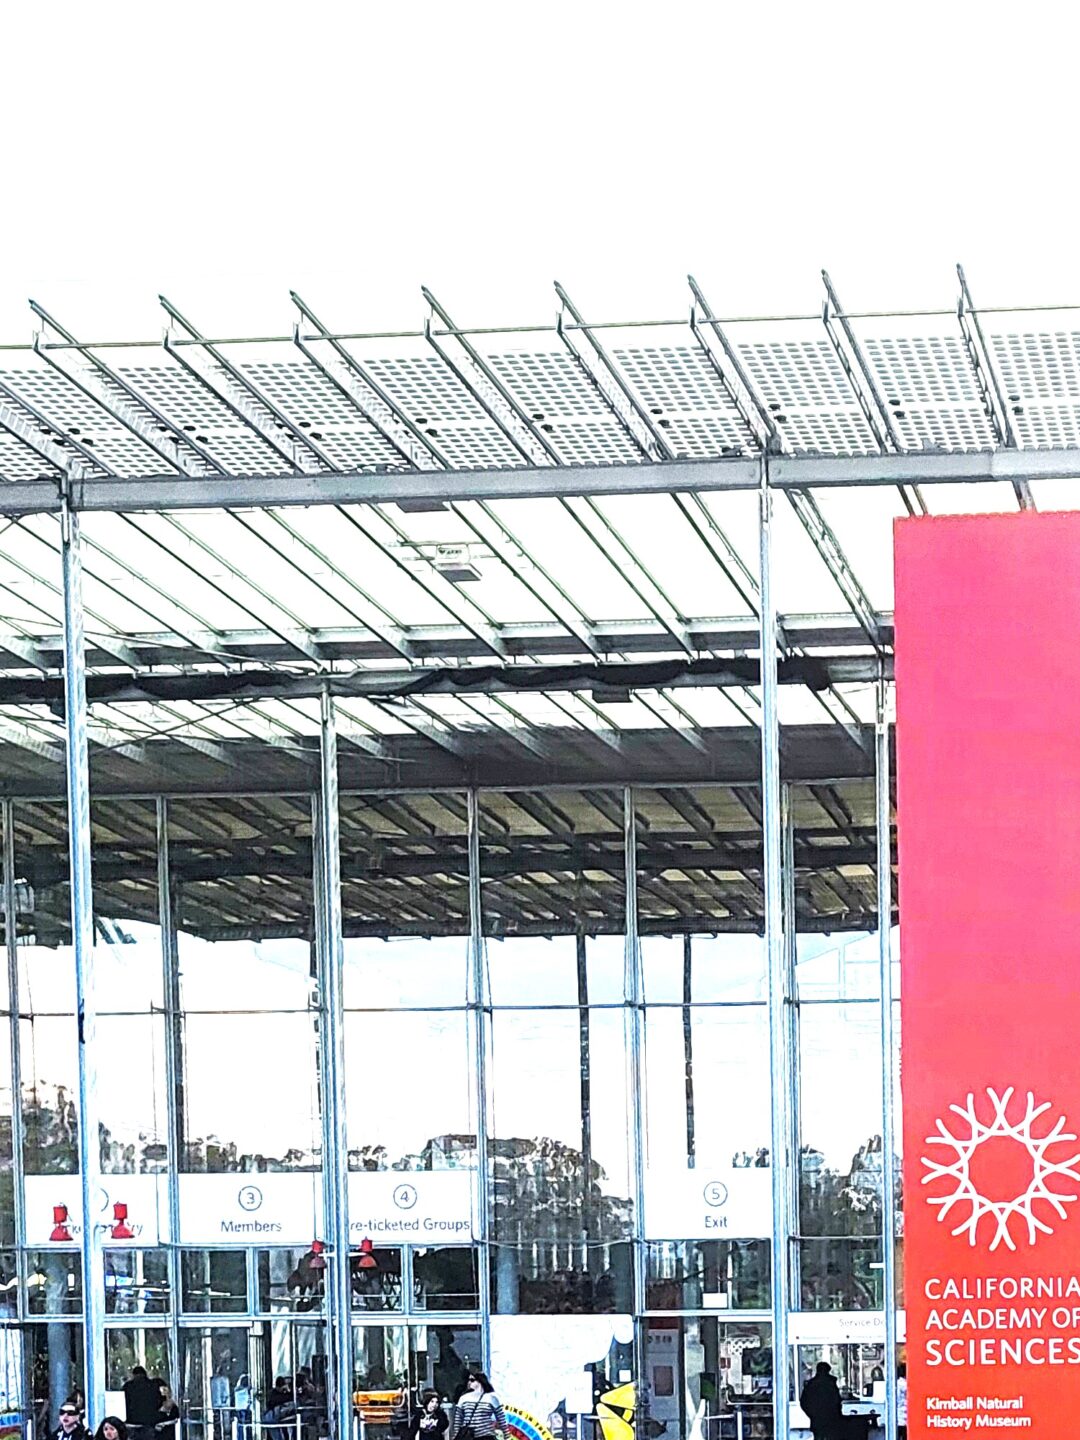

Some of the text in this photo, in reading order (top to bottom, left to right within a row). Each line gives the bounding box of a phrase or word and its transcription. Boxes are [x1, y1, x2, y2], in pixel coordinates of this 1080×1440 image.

[220, 1219, 283, 1233] Members
[350, 1217, 471, 1233] re-ticketed Groups
[704, 1215, 728, 1229] Exit
[925, 1307, 1047, 1331] ACADEMY
[926, 1396, 1024, 1410] Kimball Natural
[926, 1414, 1032, 1431] History Museum
